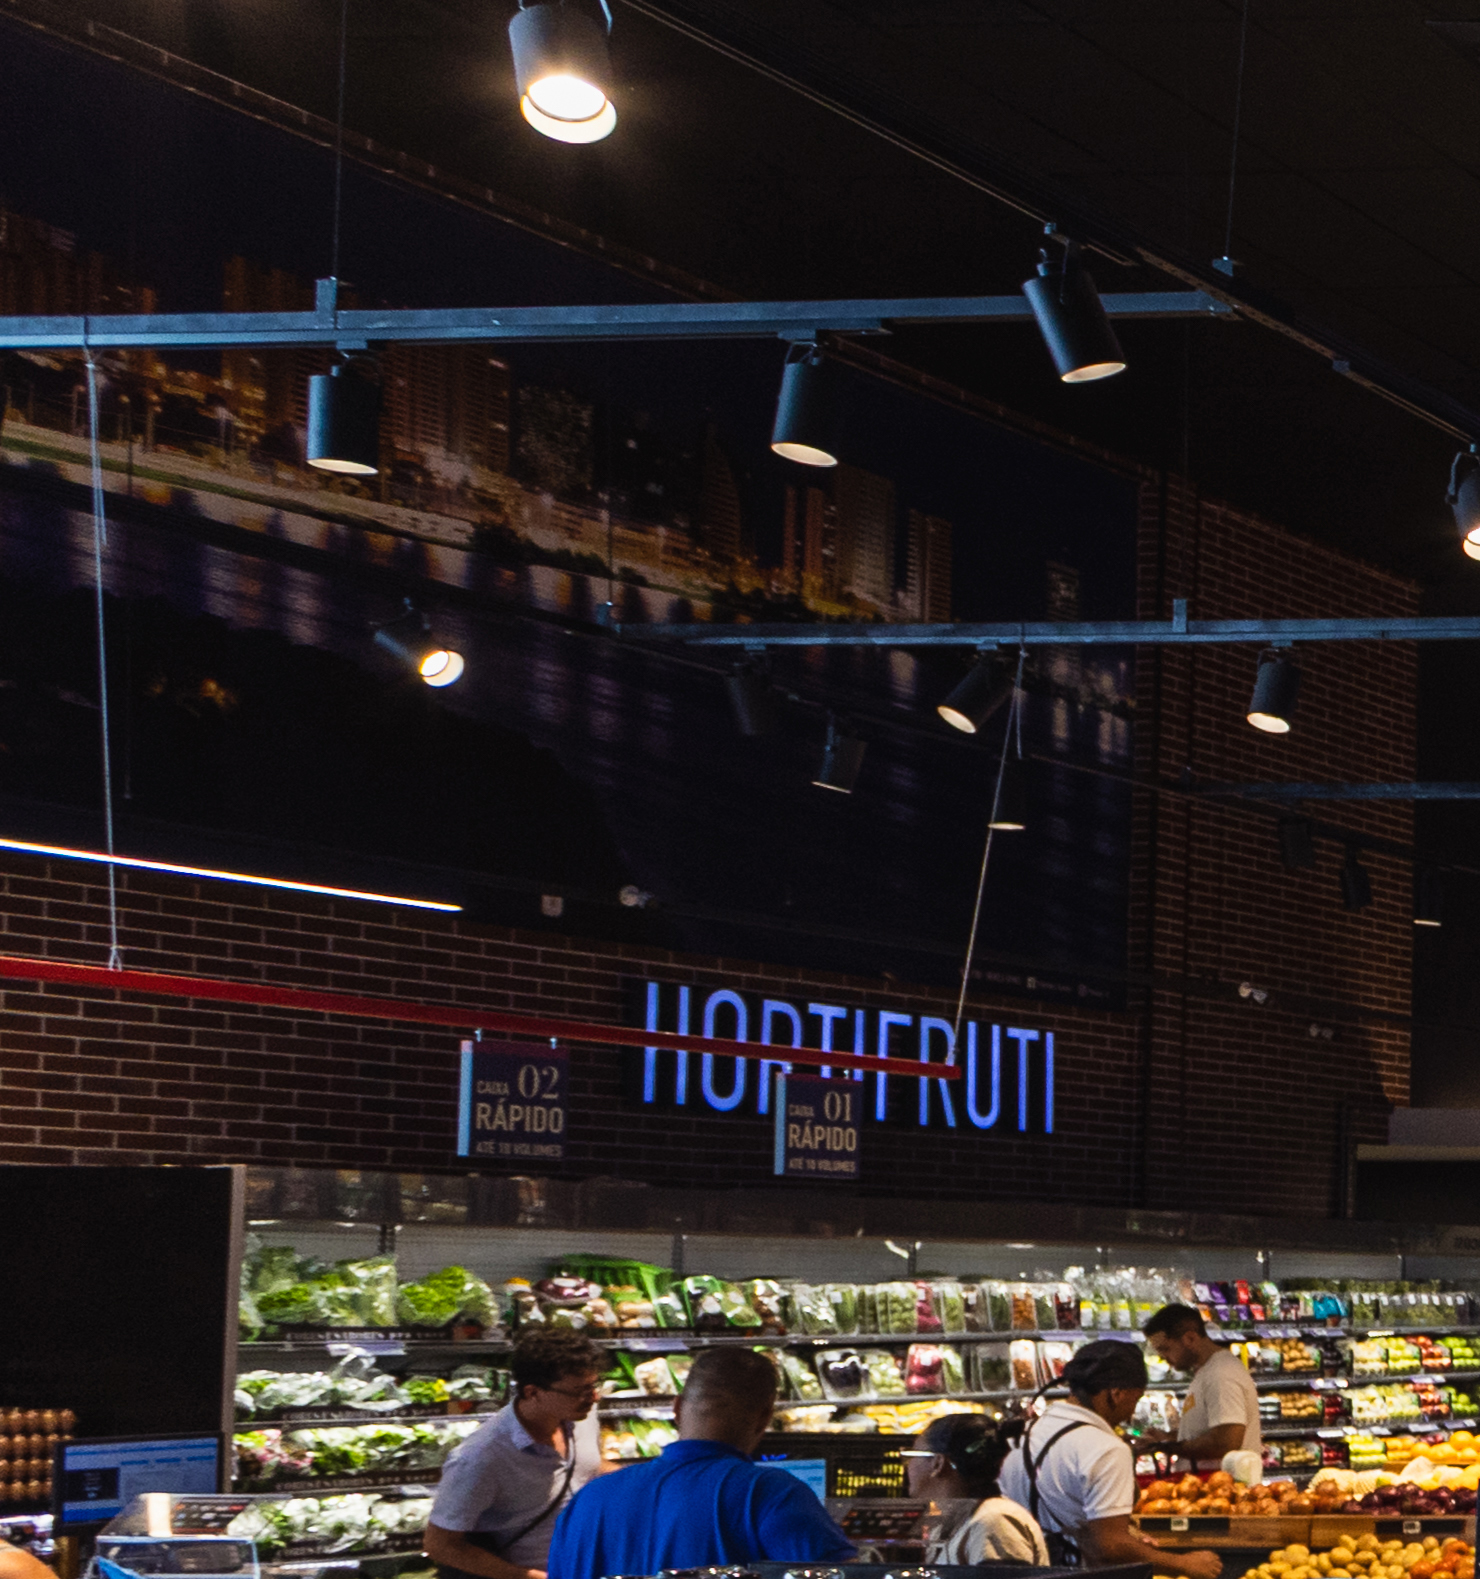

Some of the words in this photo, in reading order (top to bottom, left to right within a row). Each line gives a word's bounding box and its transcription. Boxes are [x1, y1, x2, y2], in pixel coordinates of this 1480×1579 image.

[518, 1064, 559, 1100] 02
[476, 1098, 564, 1134] RÁPIDO
[824, 1092, 851, 1121] 01
[789, 1124, 857, 1152] RÁPIDO
